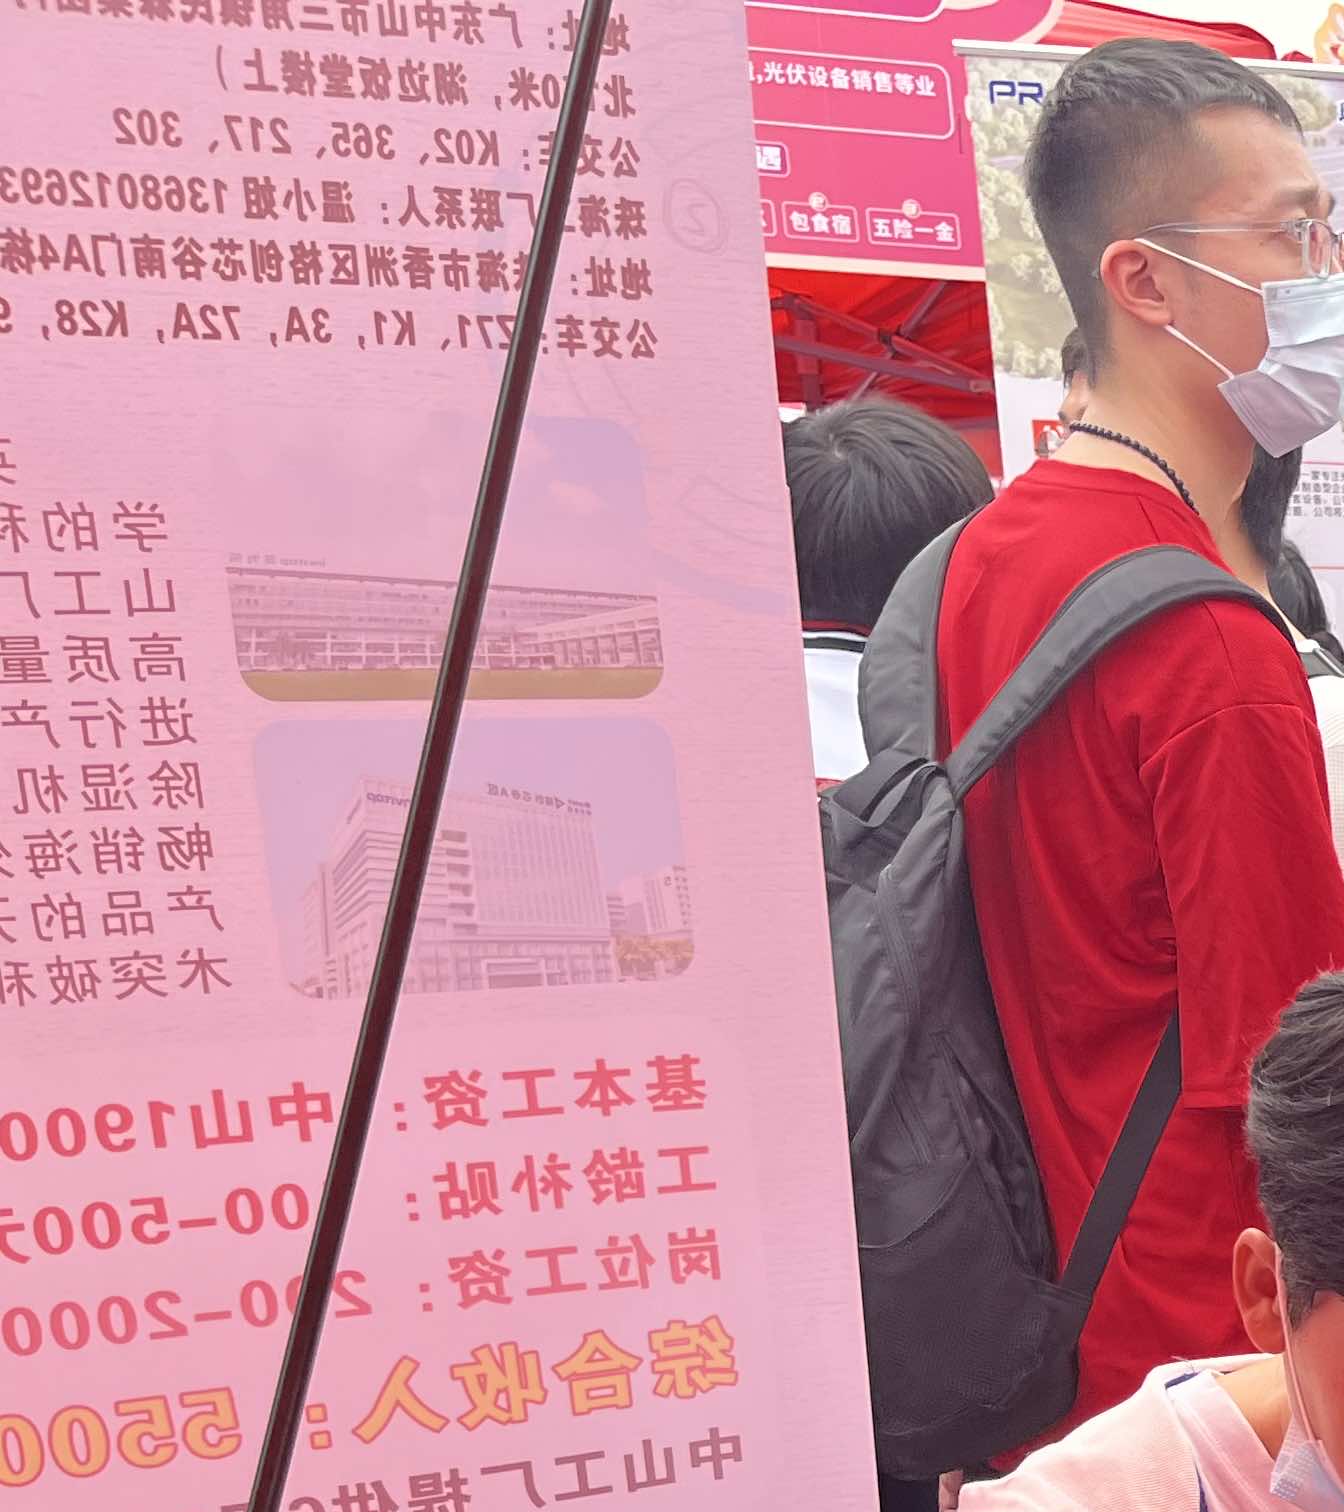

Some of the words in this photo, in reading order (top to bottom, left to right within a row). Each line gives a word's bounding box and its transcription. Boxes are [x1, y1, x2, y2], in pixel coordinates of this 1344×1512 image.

[790, 211, 851, 235] 包食宿
[873, 219, 955, 242] 五险一金
